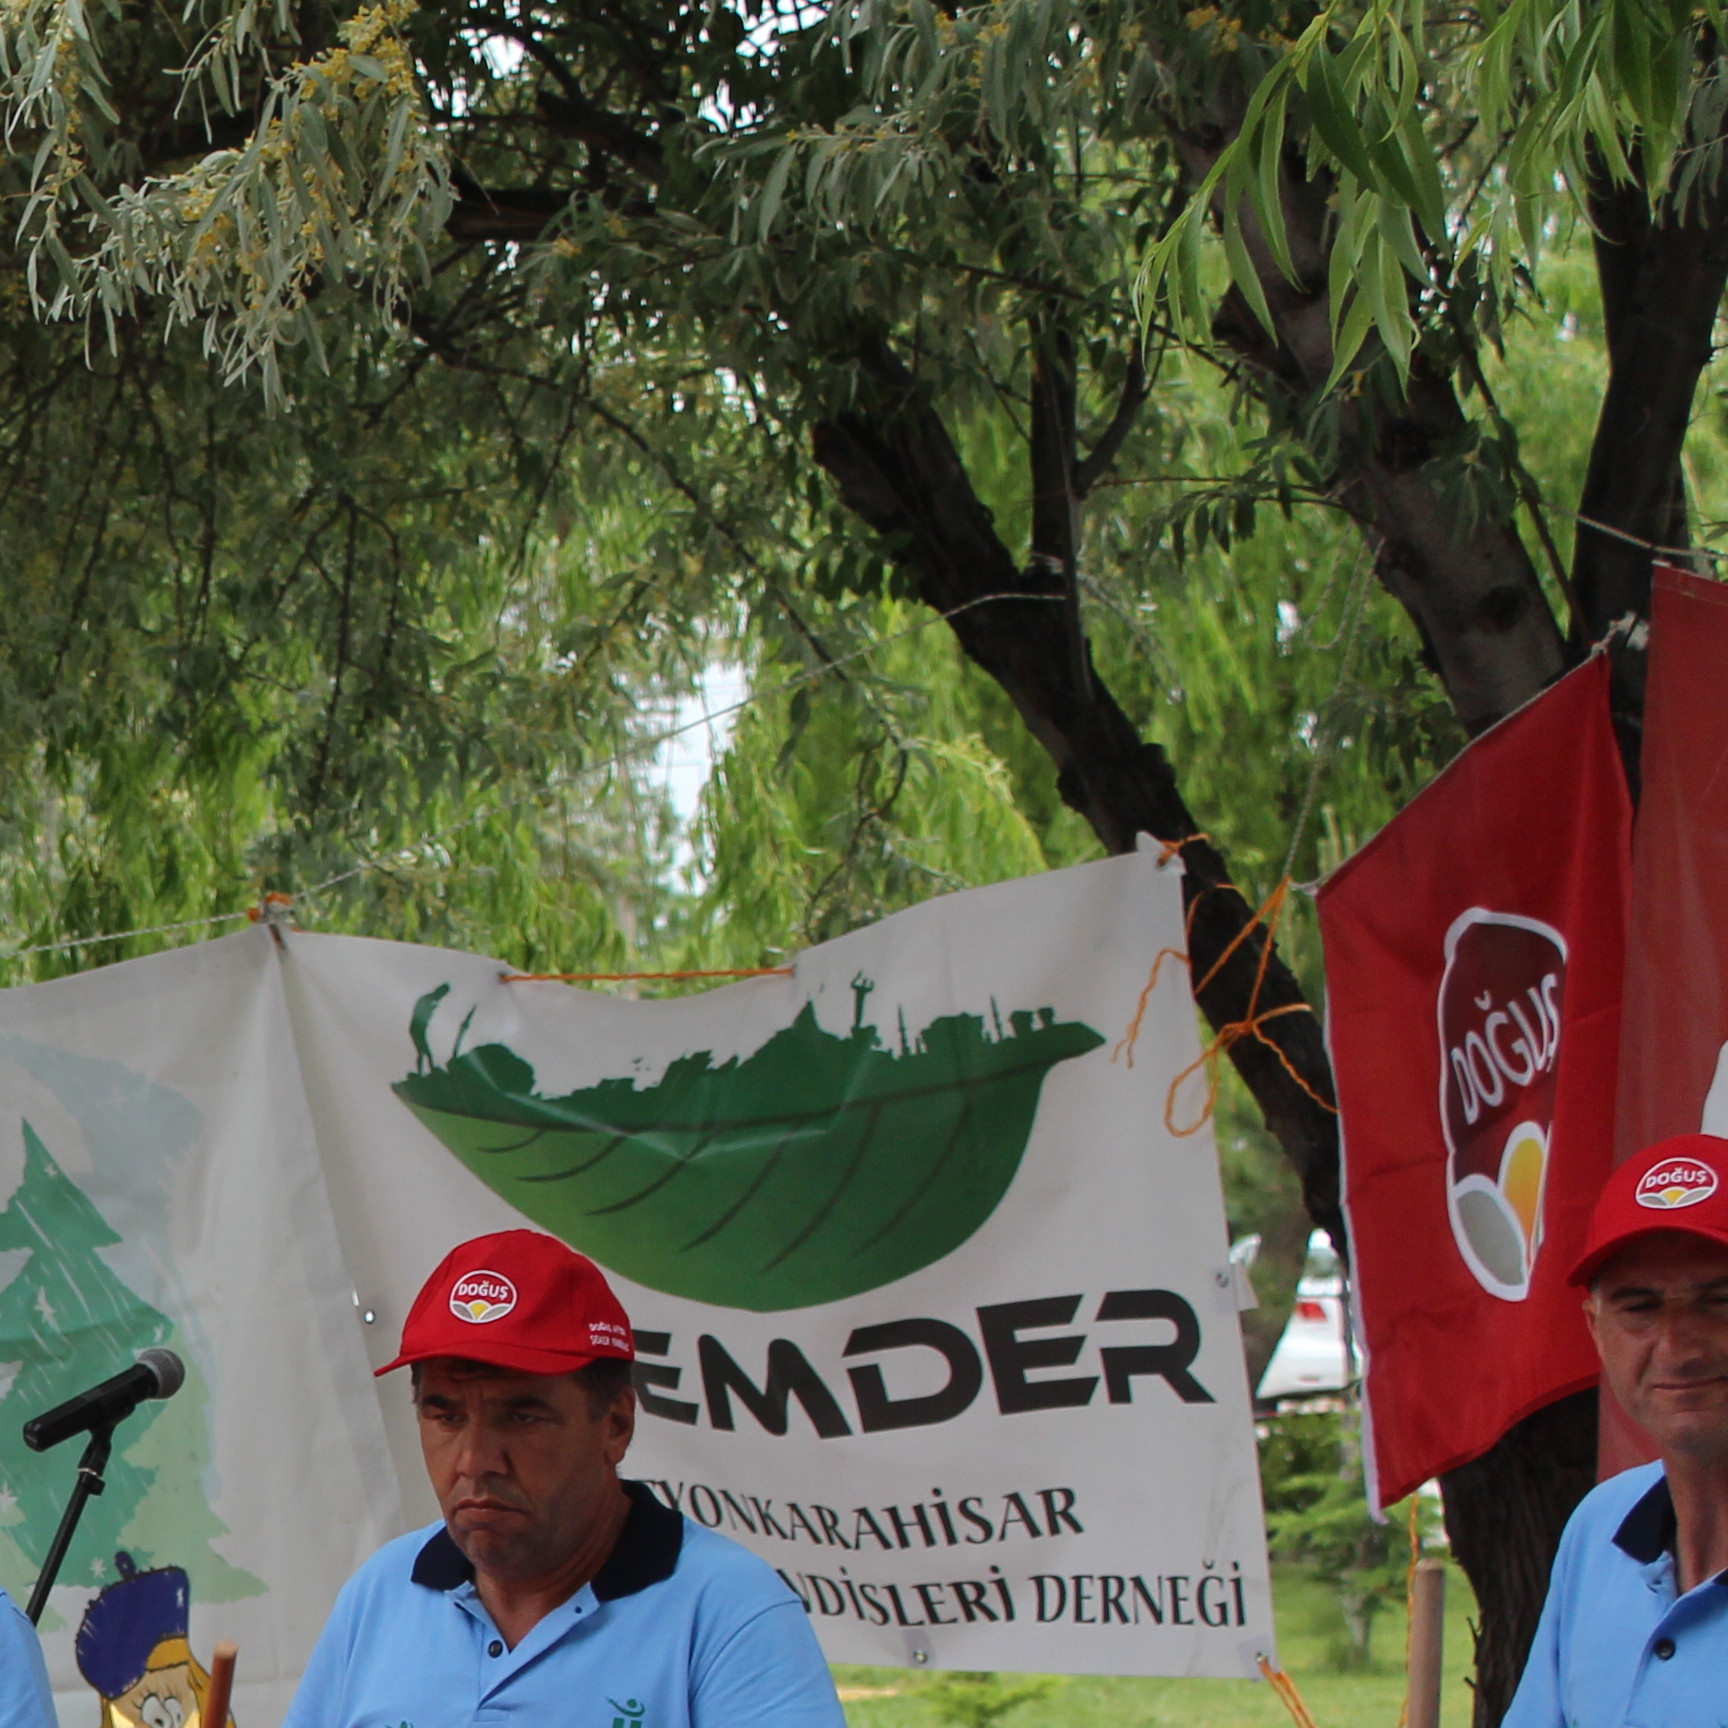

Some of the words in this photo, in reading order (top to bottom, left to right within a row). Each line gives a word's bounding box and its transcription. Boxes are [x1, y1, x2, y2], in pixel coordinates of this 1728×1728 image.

[1449, 973, 1559, 1126] DOĞUŞ
[1644, 1166, 1708, 1190] DOĞUŞ
[457, 1280, 510, 1300] DOĞUŞ
[631, 1288, 1219, 1439] EMDER
[644, 1480, 1085, 1551] YONKARAHİSAR
[1028, 1558, 1248, 1628] DERNEĞİ
